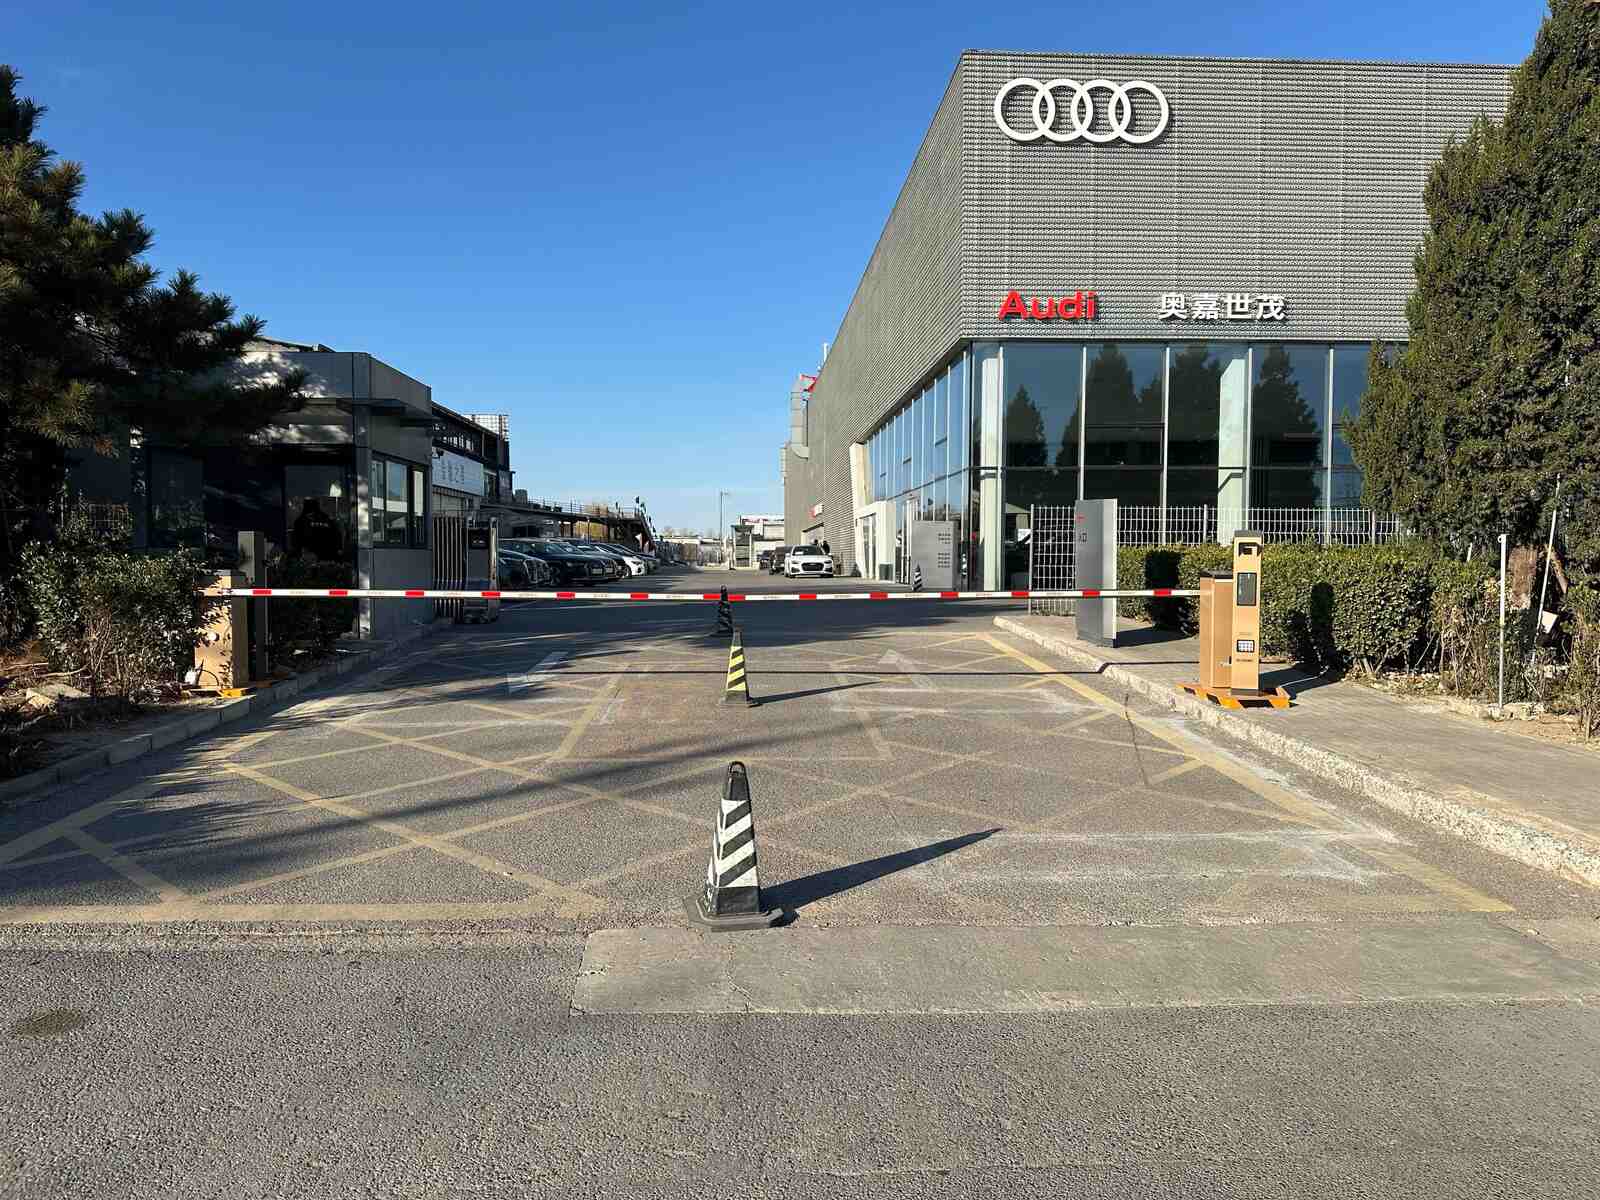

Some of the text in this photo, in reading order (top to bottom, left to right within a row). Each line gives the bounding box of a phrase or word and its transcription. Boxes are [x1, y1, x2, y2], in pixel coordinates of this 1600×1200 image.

[998, 289, 1096, 320] Audi
[1159, 292, 1286, 320] 奥嘉世茂
